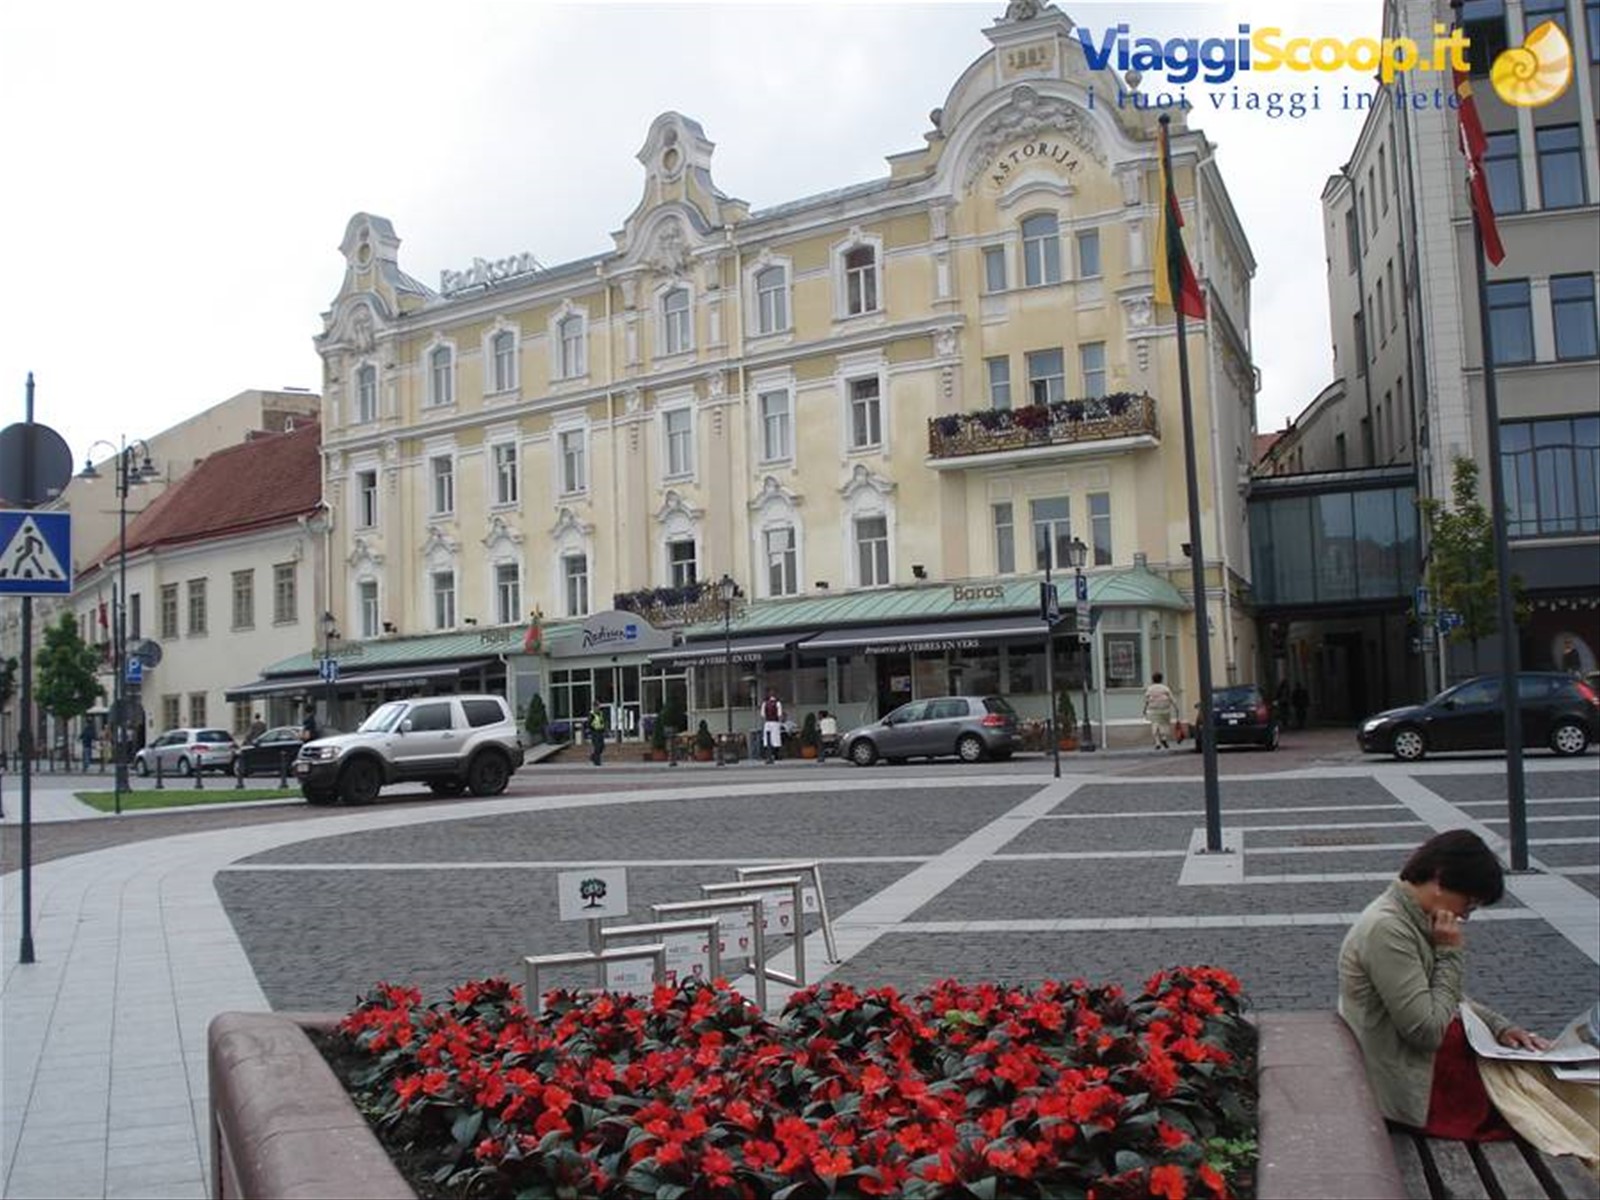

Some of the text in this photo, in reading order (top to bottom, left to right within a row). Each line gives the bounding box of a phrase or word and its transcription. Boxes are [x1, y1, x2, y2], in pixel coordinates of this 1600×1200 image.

[992, 142, 1080, 186] ASTORIJA
[953, 584, 1005, 602] Baras
[128, 657, 140, 673] P
